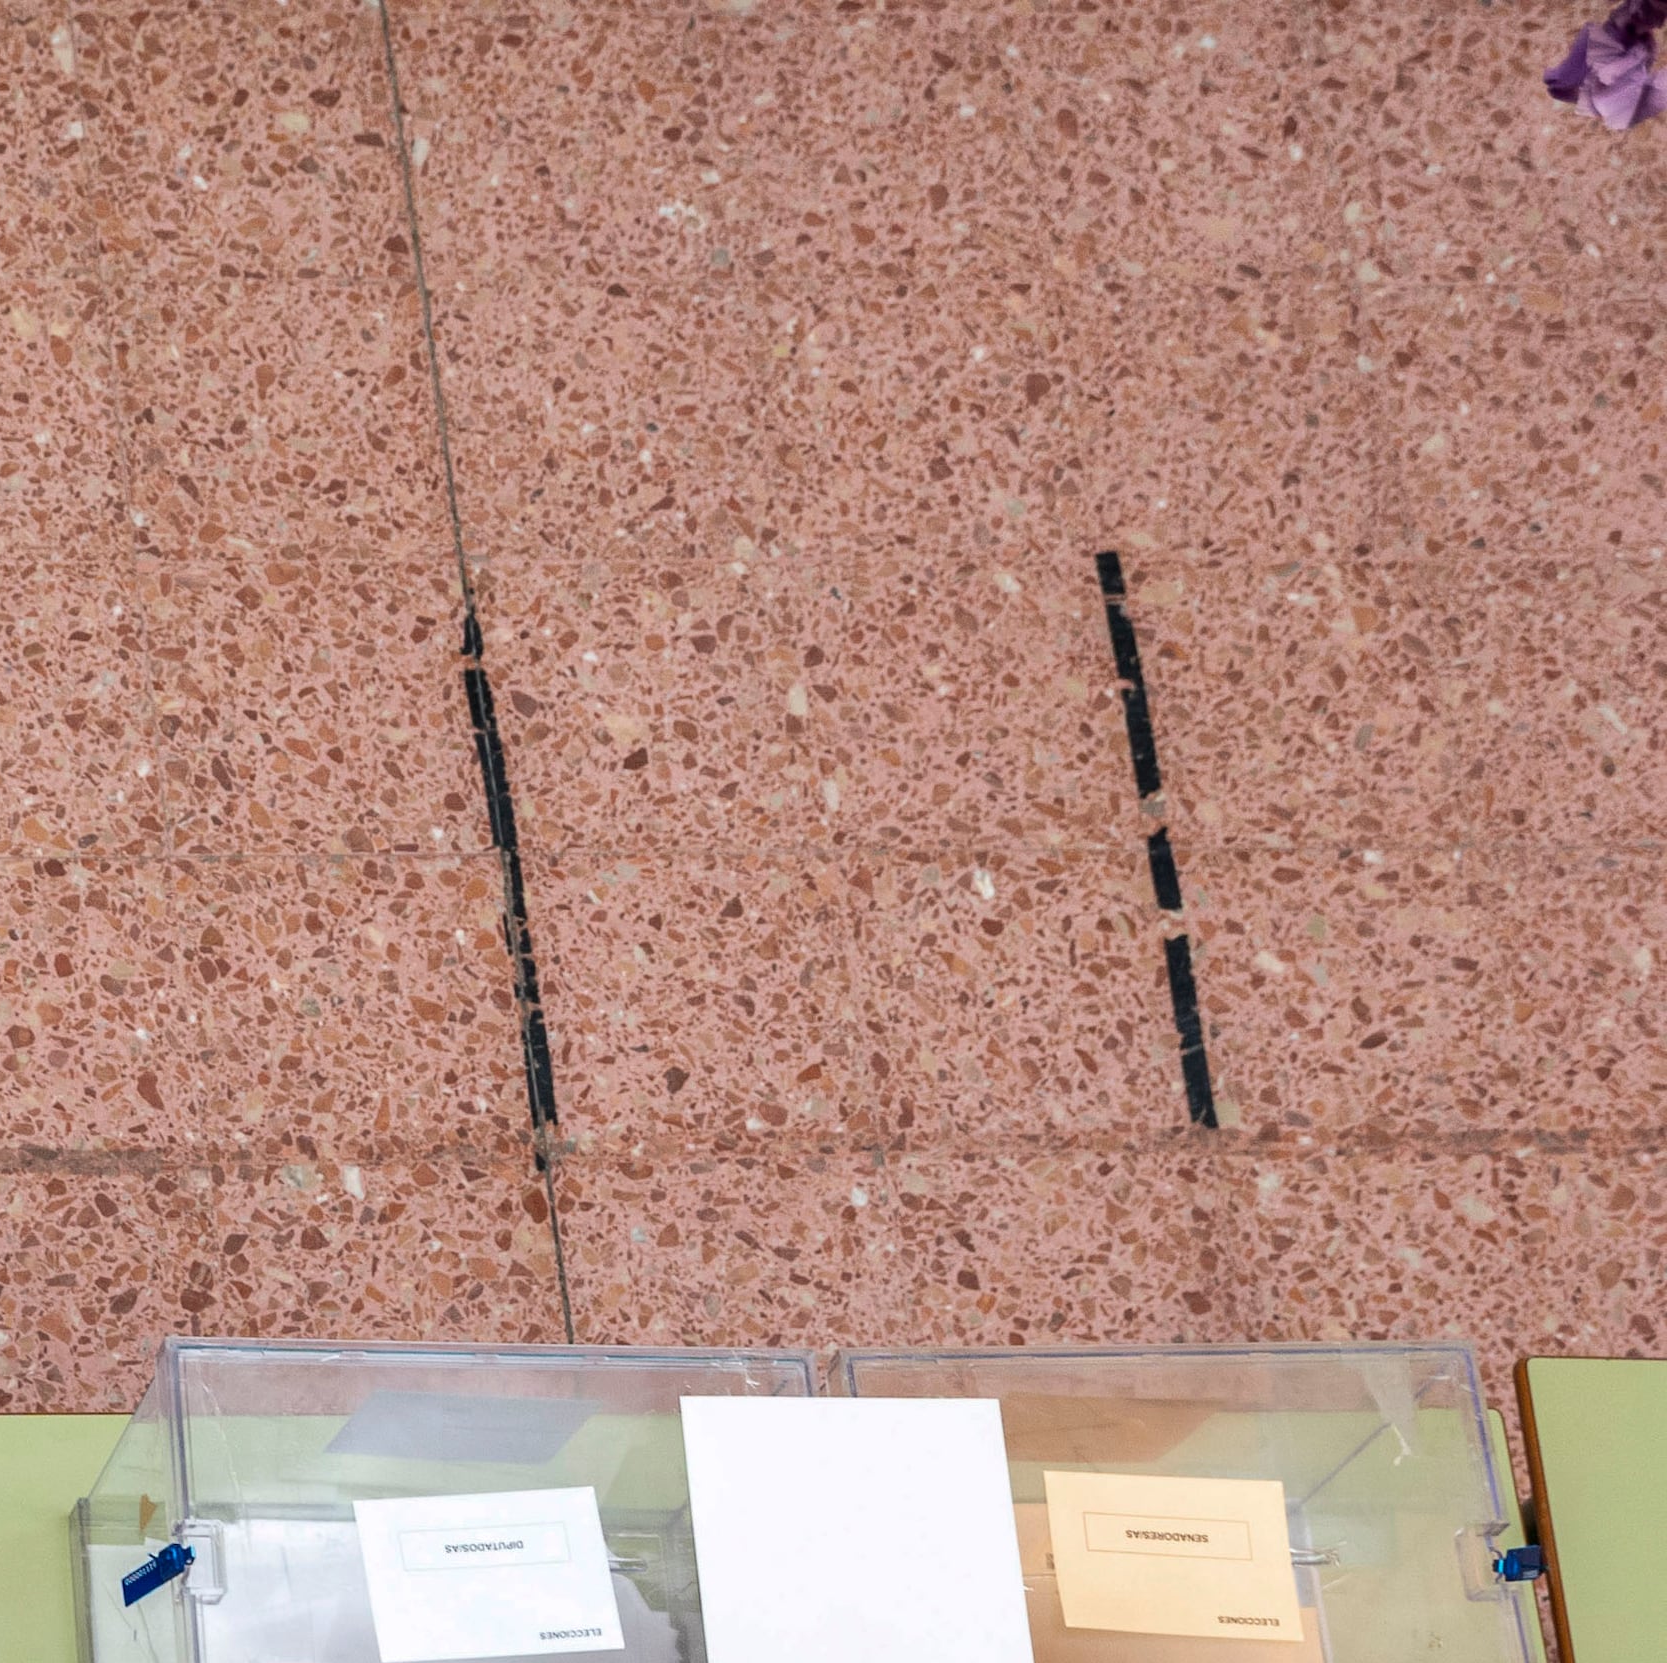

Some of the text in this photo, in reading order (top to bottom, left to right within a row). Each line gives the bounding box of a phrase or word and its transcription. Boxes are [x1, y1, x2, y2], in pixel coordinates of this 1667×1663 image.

[1124, 1529, 1209, 1543] SENADORES/AS
[444, 1540, 524, 1555] DIPUTADOS/AS
[1217, 1615, 1280, 1627] ELECCIONES
[539, 1627, 602, 1641] ELECCIONES
